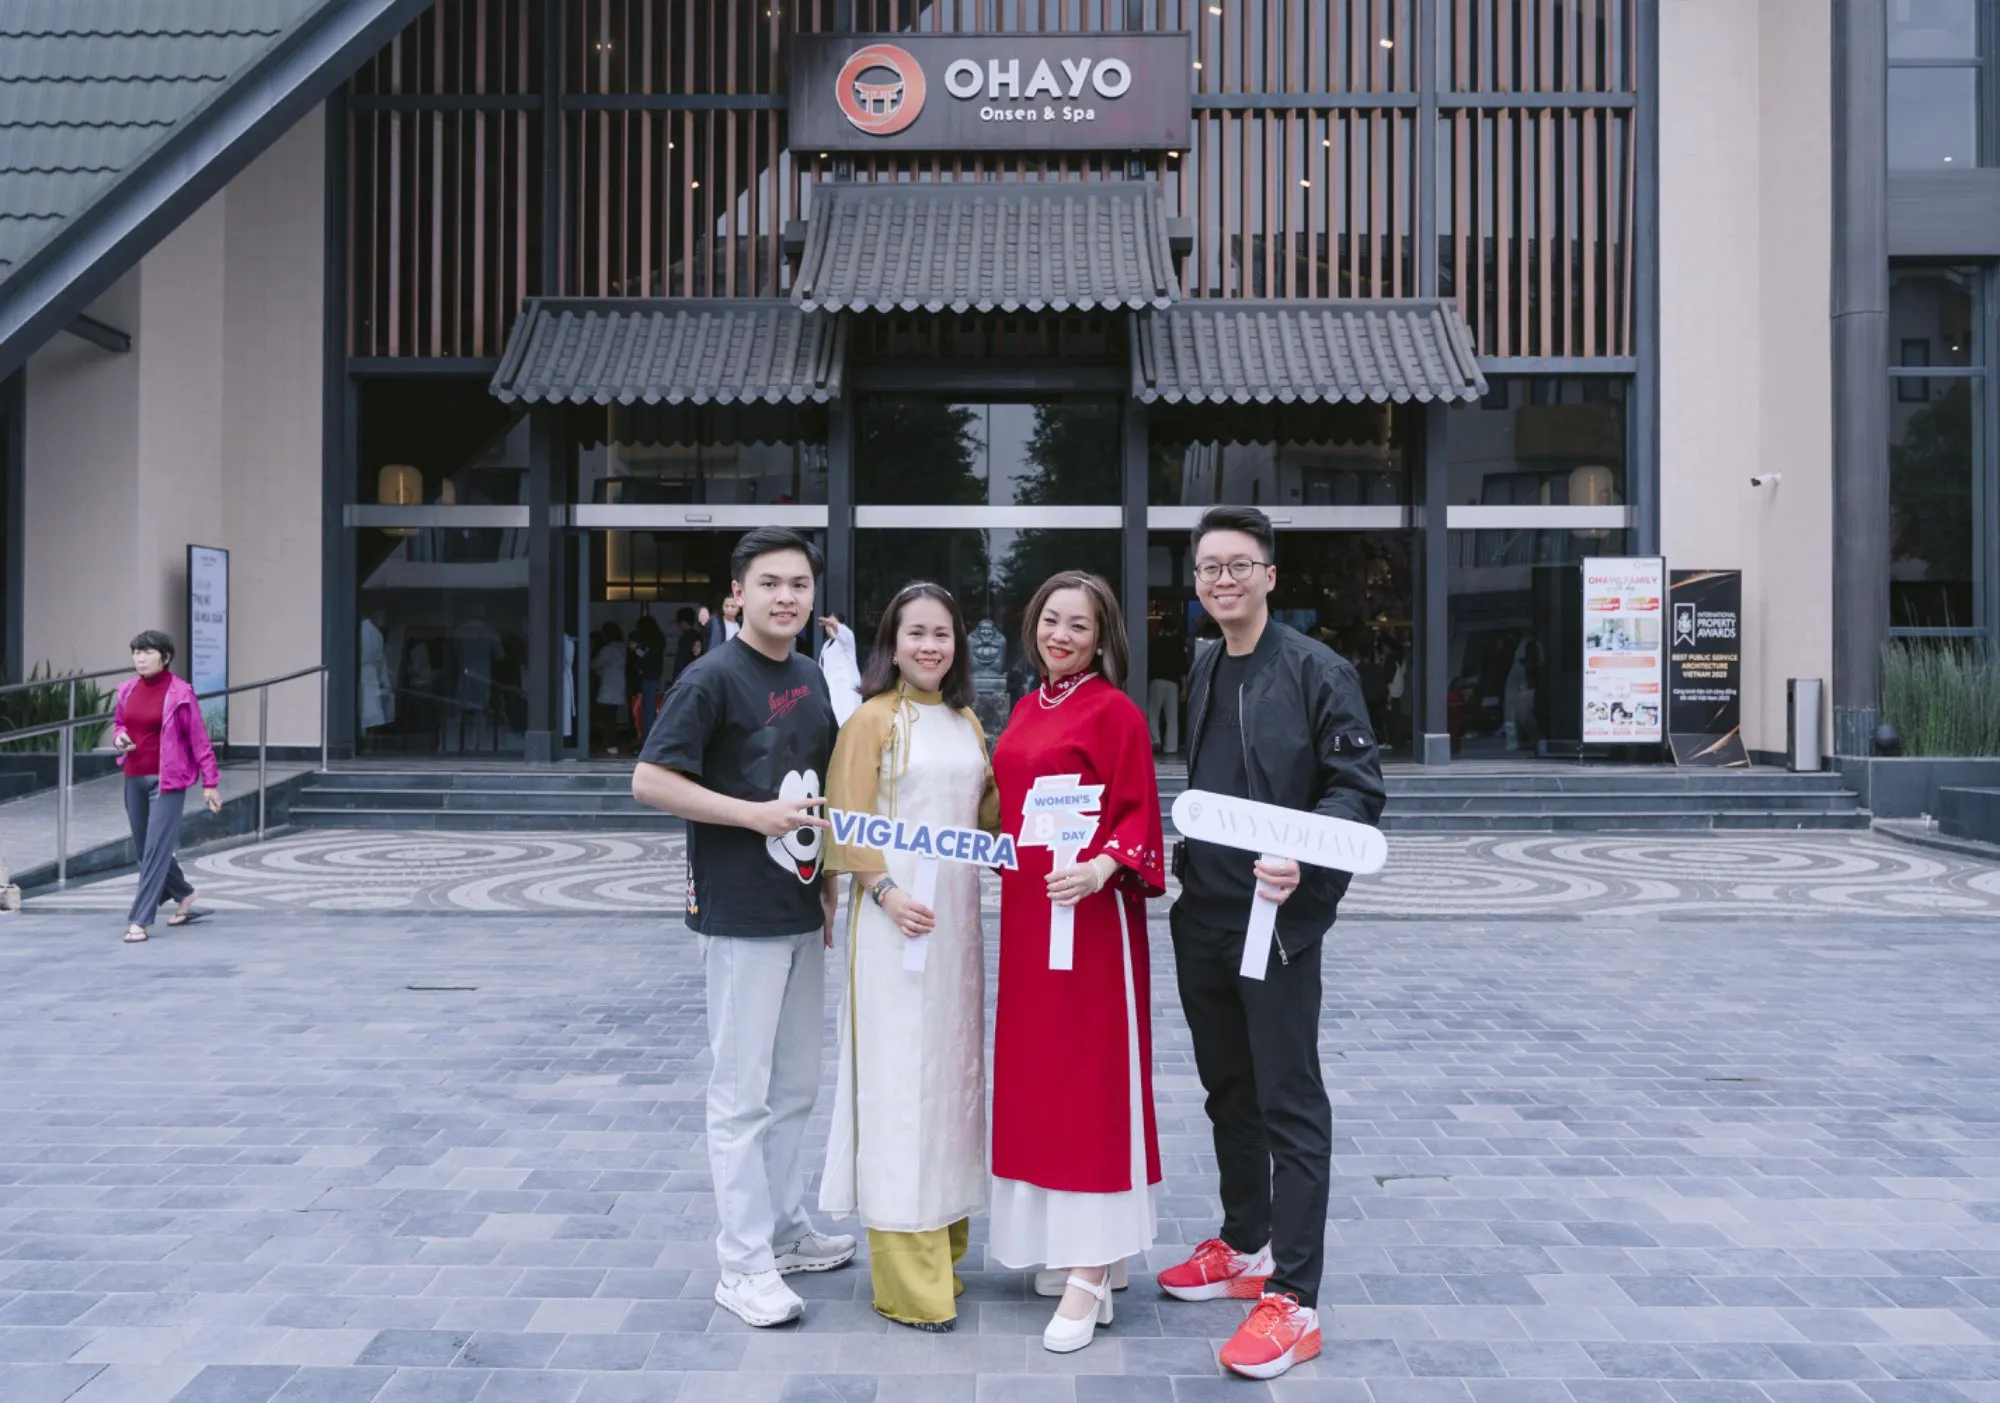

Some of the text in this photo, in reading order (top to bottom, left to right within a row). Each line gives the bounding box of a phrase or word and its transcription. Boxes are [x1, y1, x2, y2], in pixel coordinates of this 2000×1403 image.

[944, 58, 1131, 99] OHAYO
[980, 106, 1096, 122] Onsen & Spa
[1697, 619, 1737, 628] PROPERTY
[1697, 628, 1737, 638] AWARDS
[1034, 794, 1091, 807] WOMEN'S
[1034, 812, 1056, 840] 8
[832, 811, 1016, 867] VIGLACERA
[1061, 830, 1086, 841] DAY
[1217, 808, 1369, 861] WYNDHAM
